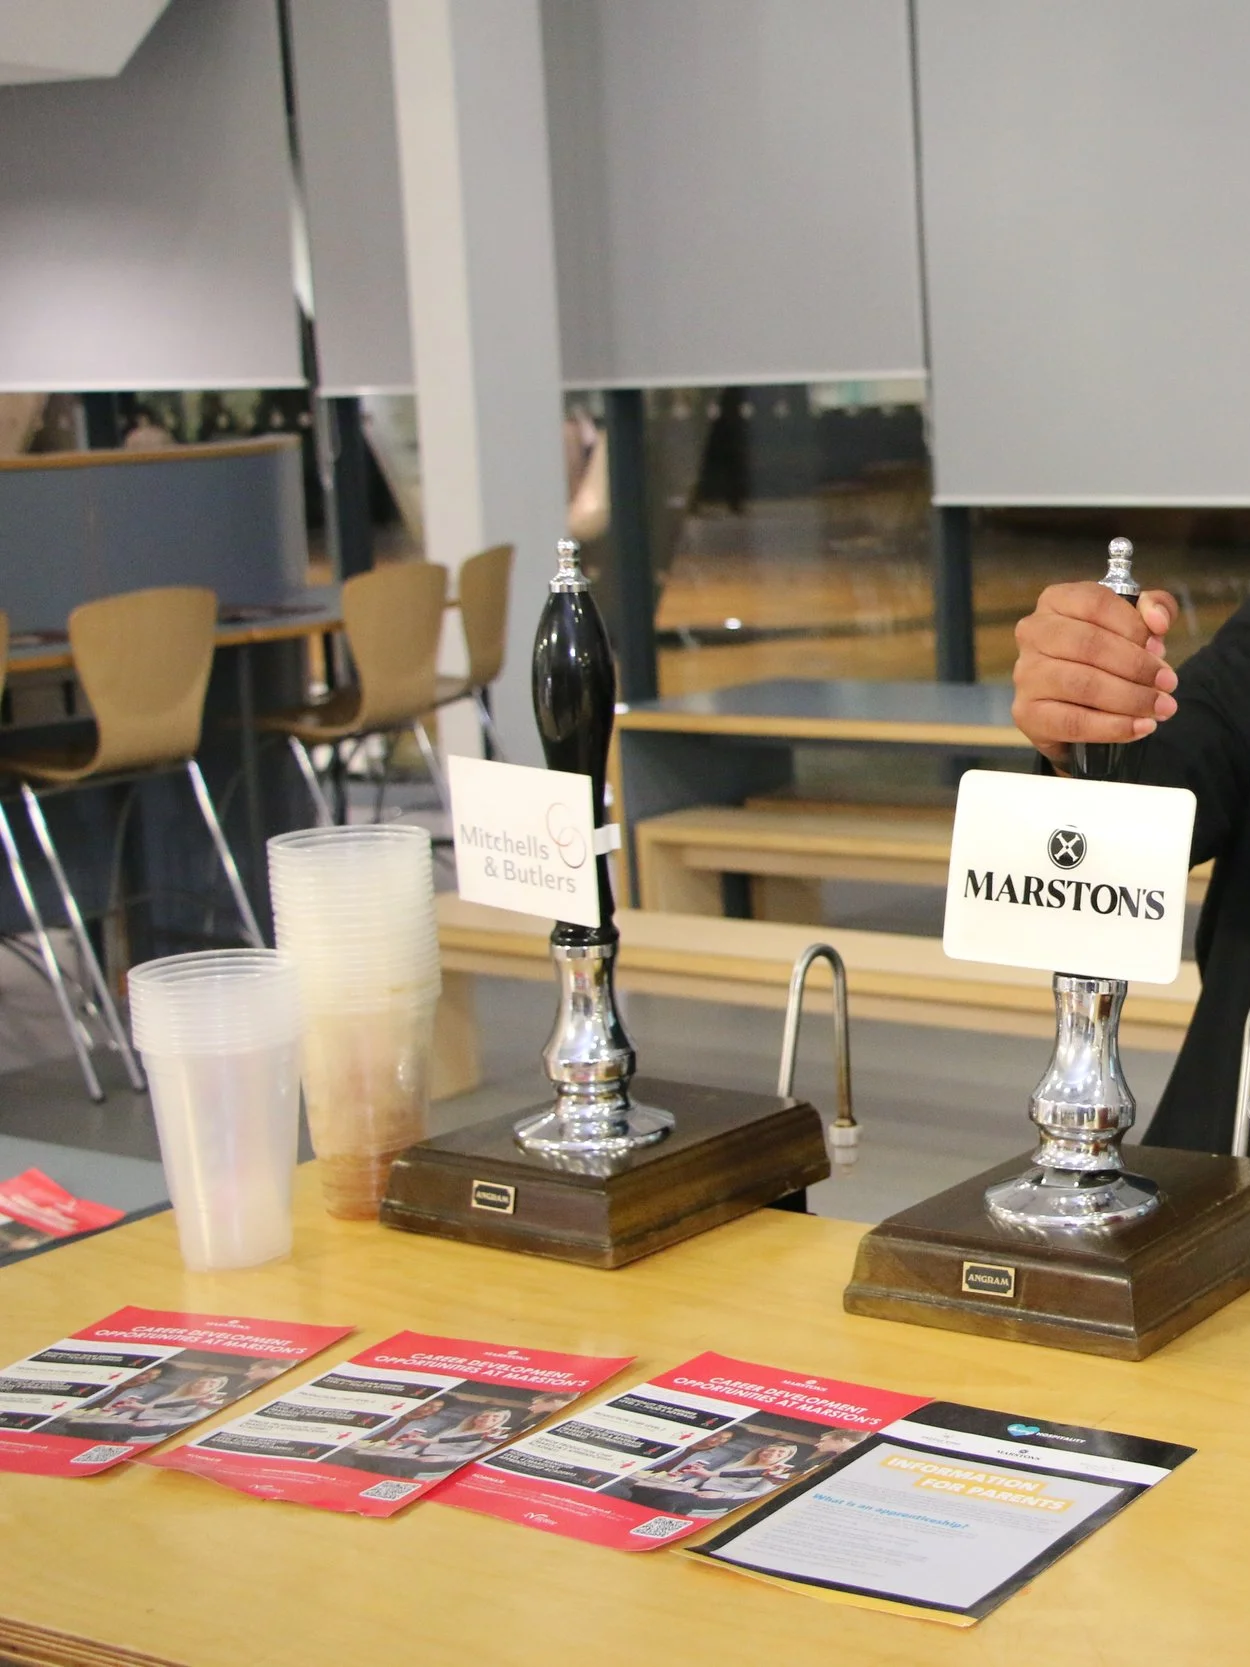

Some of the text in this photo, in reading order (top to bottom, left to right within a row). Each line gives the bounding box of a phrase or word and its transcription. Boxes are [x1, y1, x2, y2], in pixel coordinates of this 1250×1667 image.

[460, 823, 550, 860] Mitchells
[484, 856, 577, 893] & Butlers
[964, 868, 1165, 920] MARSTON'S
[967, 1273, 1009, 1287] ANGRAM
[374, 1355, 482, 1374] OPPORTUNITIES
[502, 1371, 590, 1387] MARSTON'S
[410, 1353, 575, 1379] CAREER DEVELOPMENT
[673, 1377, 778, 1404] OPPORTUNITIES
[797, 1403, 883, 1426] MARSTON'S
[709, 1377, 869, 1414] CAREER DEVELOPMENT
[887, 1457, 1041, 1492] INFORMATION
[812, 1492, 846, 1505] What
[920, 1478, 966, 1494] FOR
[966, 1486, 1066, 1511] PARENTS
